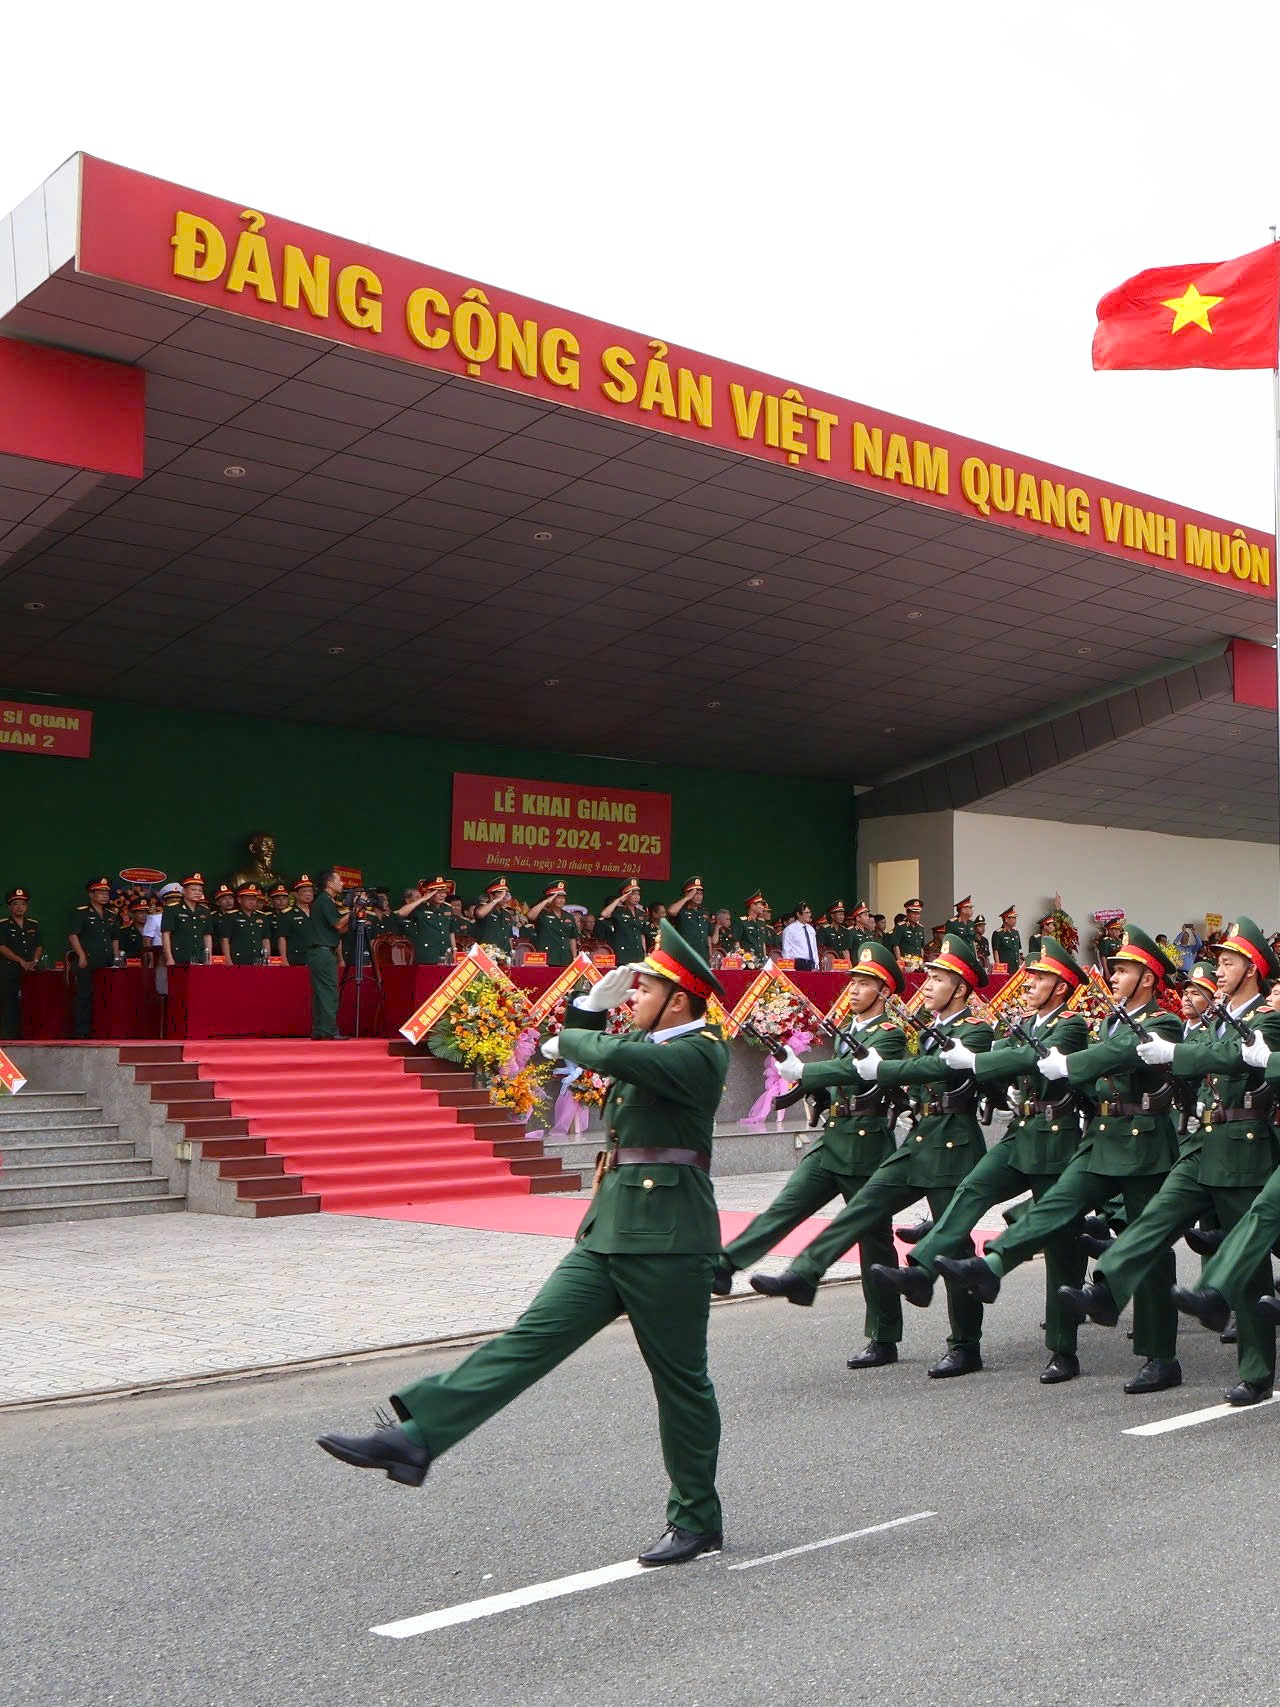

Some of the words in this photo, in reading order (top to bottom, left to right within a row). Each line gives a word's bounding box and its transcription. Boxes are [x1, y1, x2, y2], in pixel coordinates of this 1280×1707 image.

[171, 209, 383, 334] ĐẢNG
[406, 289, 580, 390] CỘNG
[601, 340, 713, 429] SẢN
[730, 384, 839, 464] VIỆT
[852, 421, 949, 496] NAM
[961, 457, 1090, 536] QUANG
[1100, 496, 1176, 561] VINH
[1184, 523, 1270, 587] MUÔN
[29, 713, 79, 730] QUAN
[0, 729, 37, 746] UÂN
[42, 735, 55, 748] 2
[494, 786, 515, 813] LỄ
[522, 793, 571, 818] KHAI
[577, 796, 637, 824] GIẢNG
[463, 819, 506, 843] NĂM
[511, 824, 550, 849] HỌC
[555, 828, 602, 851] 2024
[617, 833, 662, 855] 2025
[486, 852, 511, 868] Đồng
[513, 855, 532, 868] Nai,
[533, 858, 554, 871] ngày
[557, 859, 568, 870] 20
[568, 860, 593, 874] tháng
[595, 862, 601, 872] 9
[622, 863, 642, 875] 2024
